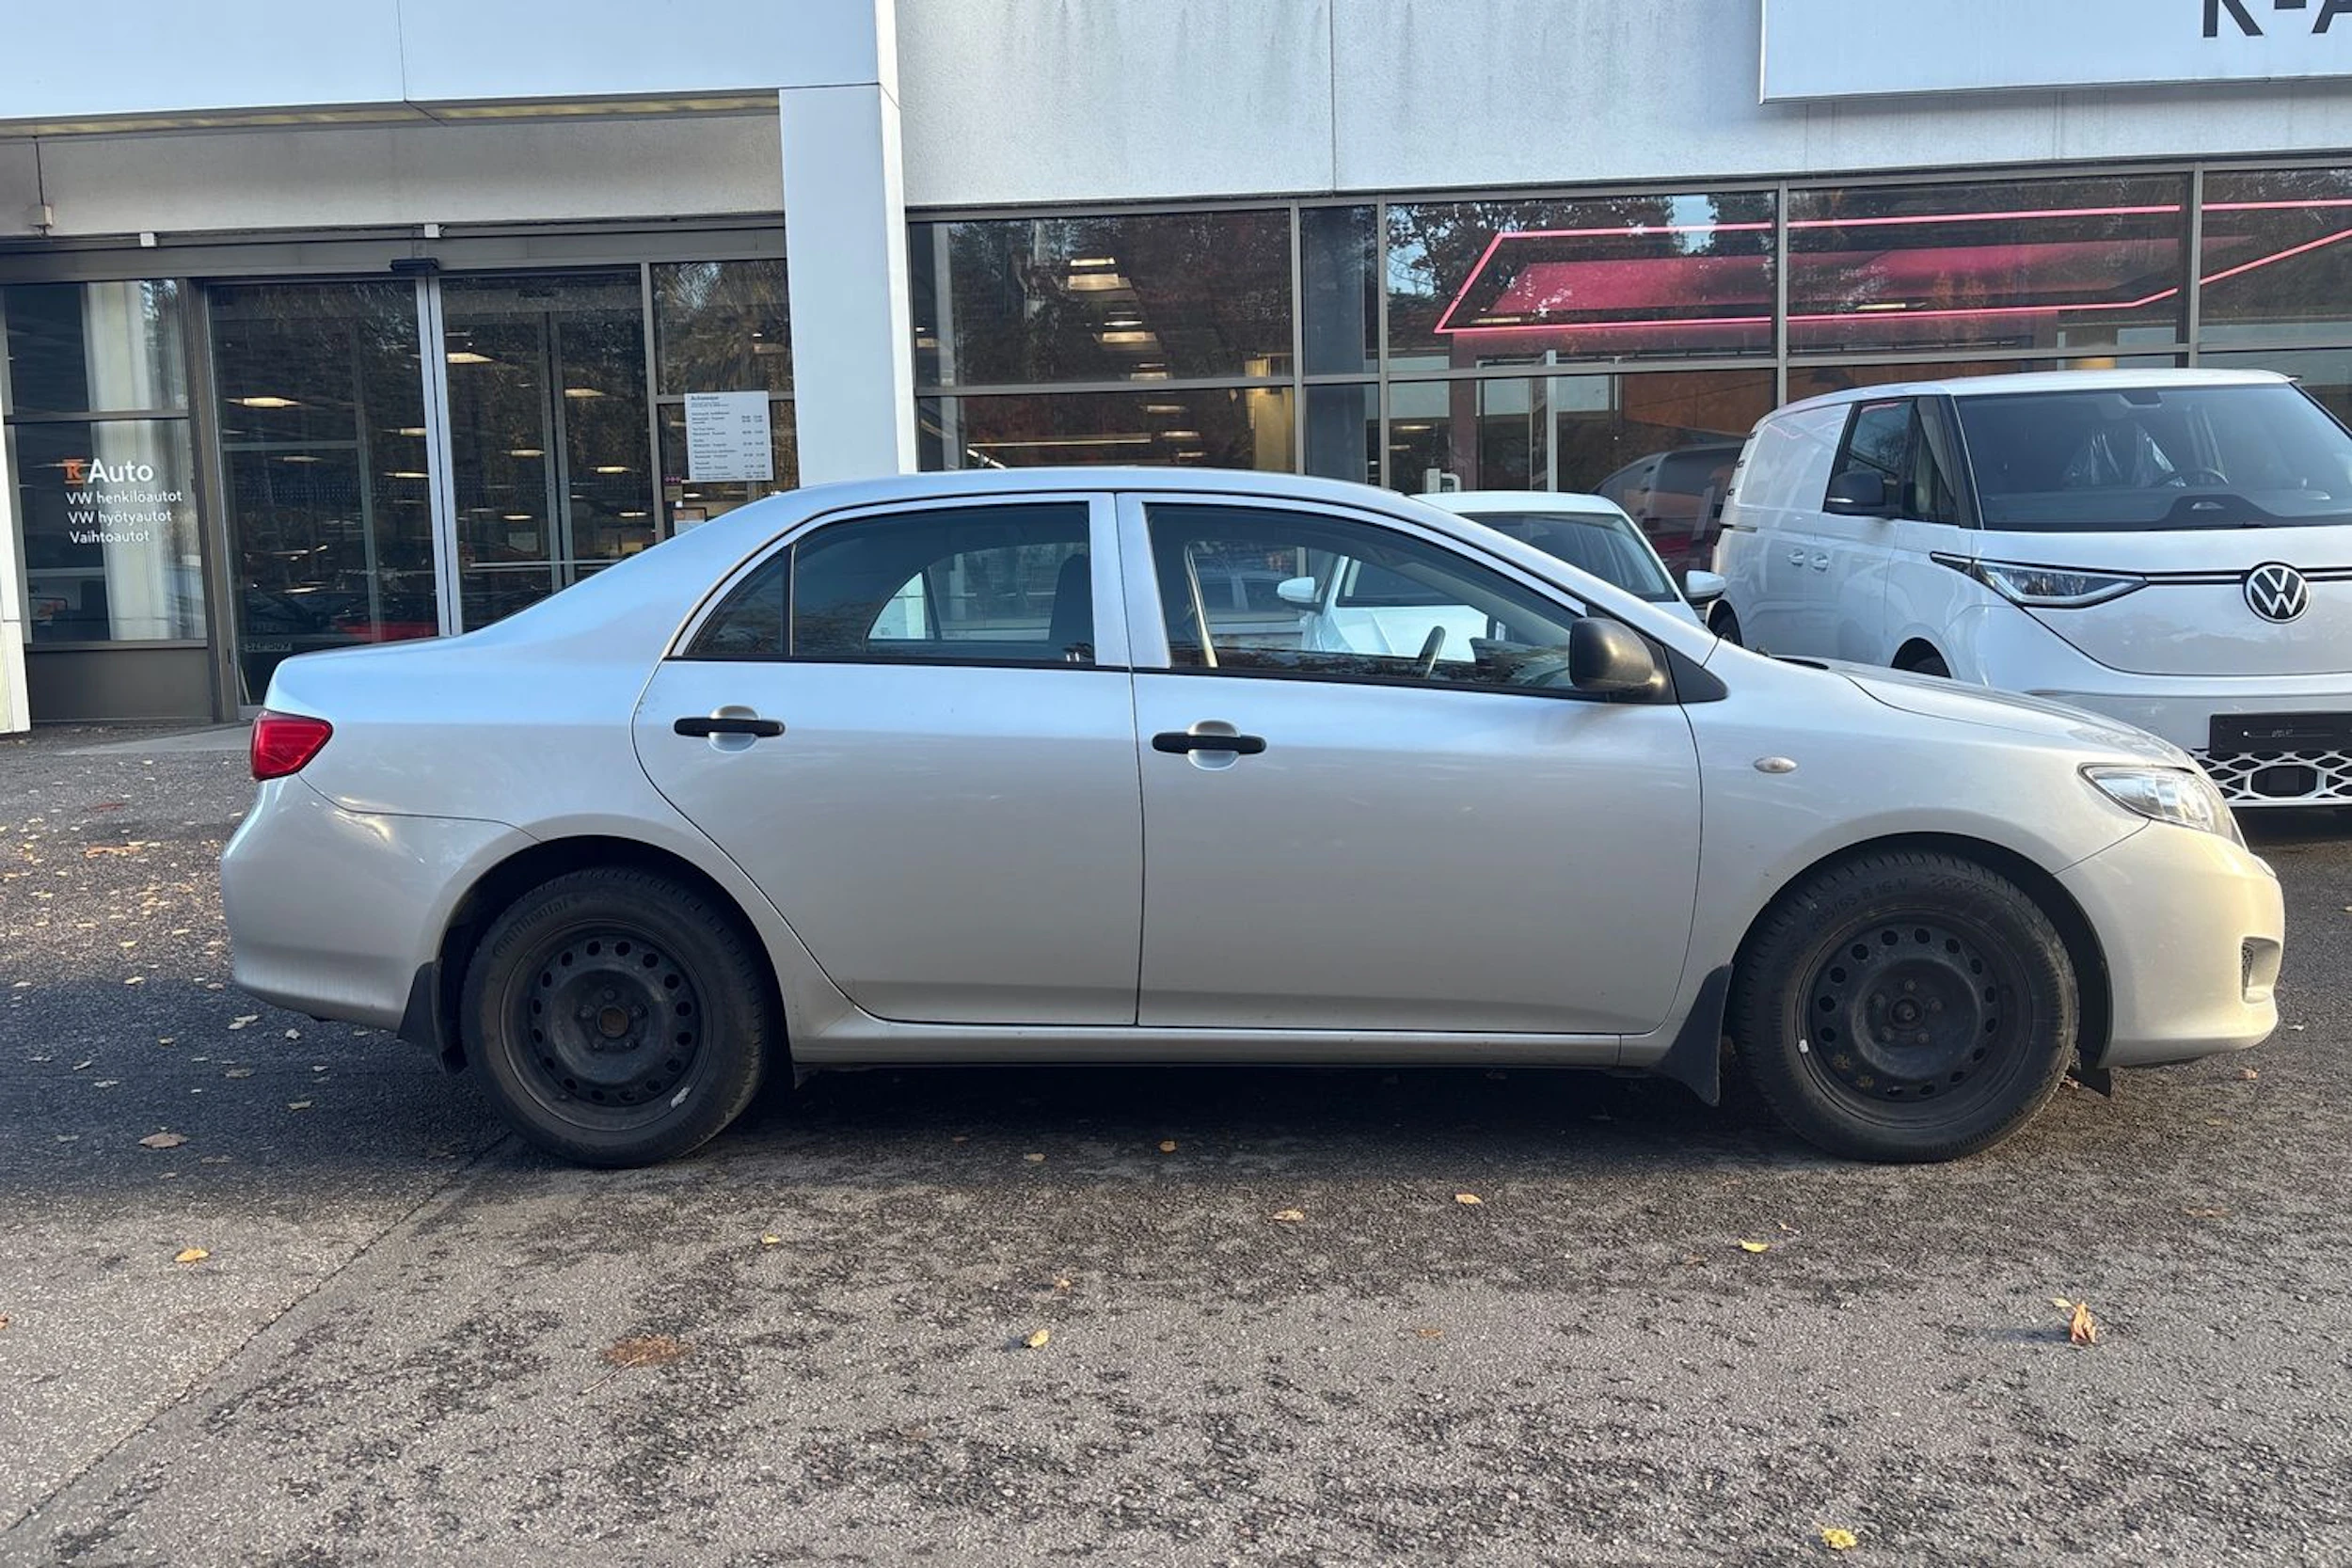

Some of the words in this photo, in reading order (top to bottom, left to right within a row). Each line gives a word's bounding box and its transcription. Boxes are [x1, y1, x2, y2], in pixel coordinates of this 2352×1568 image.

[87, 458, 154, 483] Auto
[66, 491, 93, 504] VW
[96, 490, 183, 504] henkilöautot
[68, 511, 94, 524] VW
[98, 510, 171, 526] hyötyautot
[69, 530, 150, 544] Vaihtoautot
[2247, 564, 2308, 620] VW
